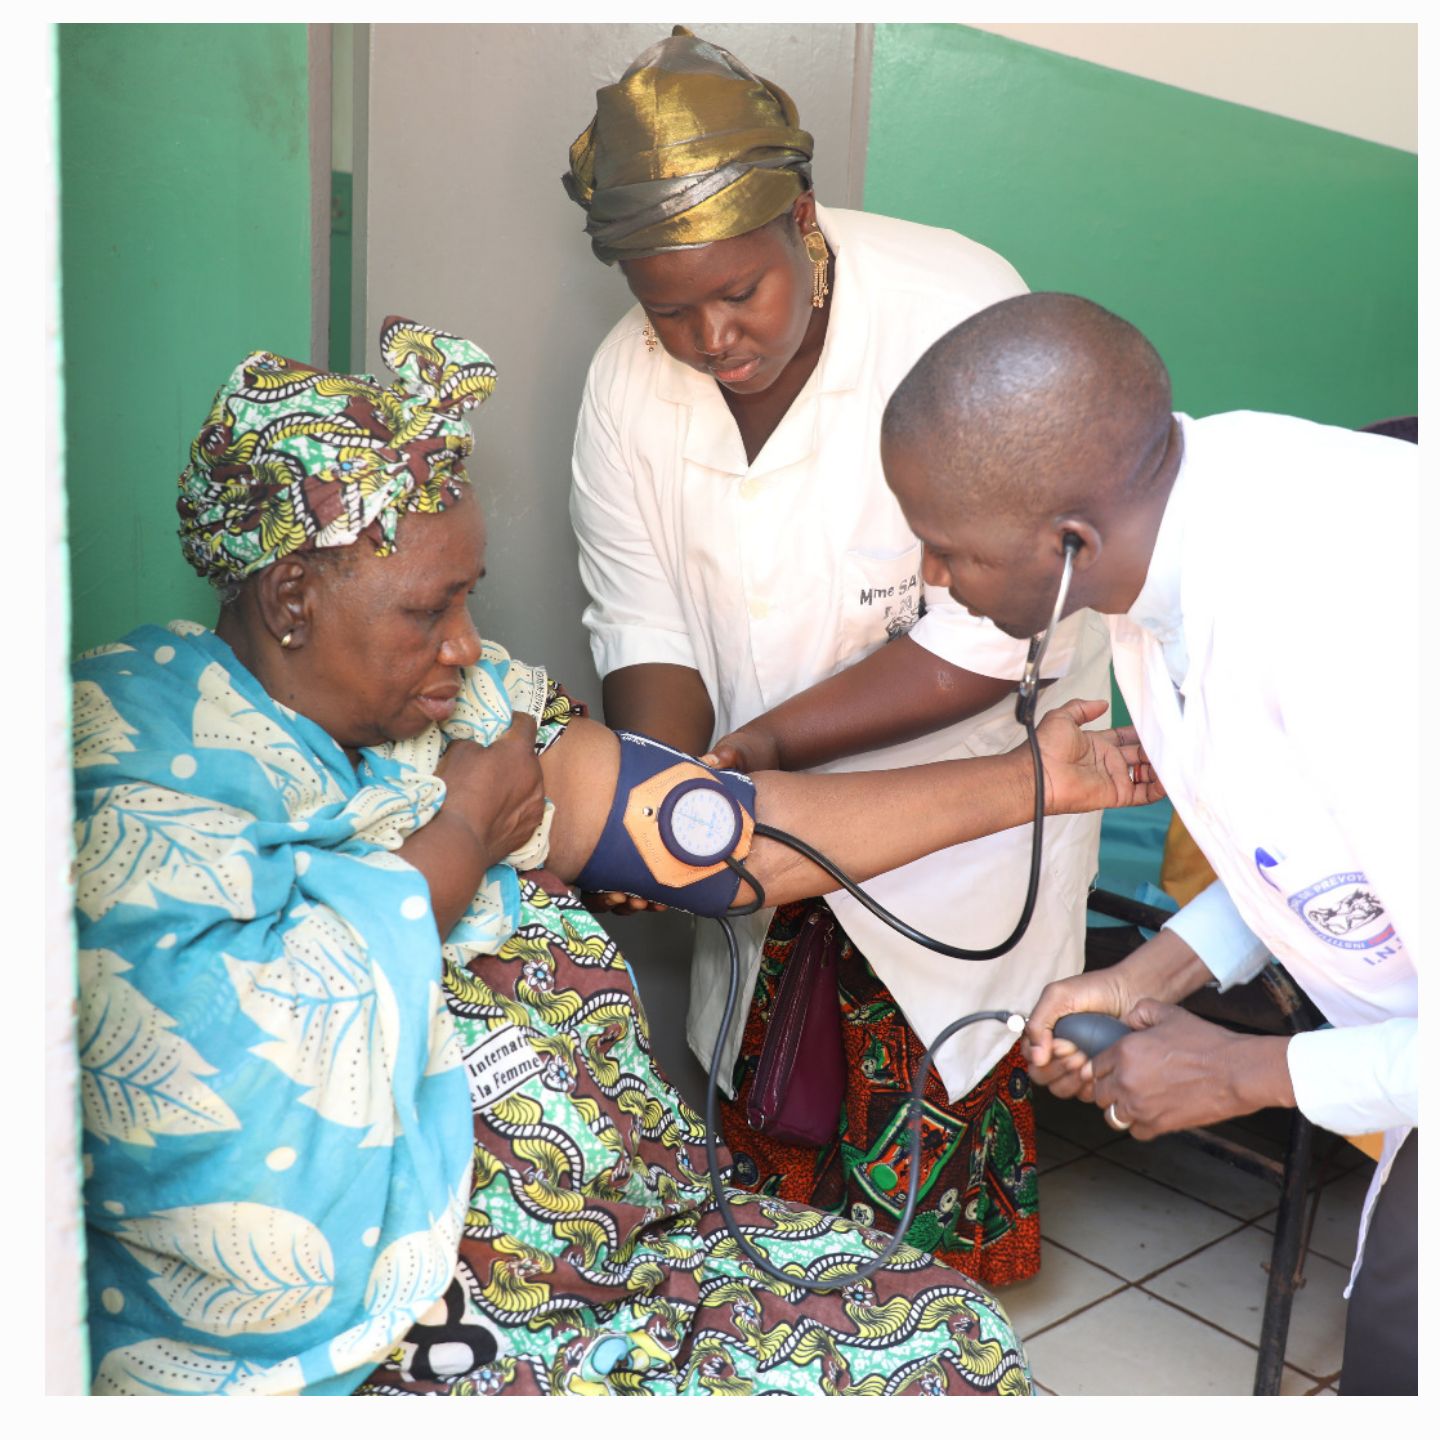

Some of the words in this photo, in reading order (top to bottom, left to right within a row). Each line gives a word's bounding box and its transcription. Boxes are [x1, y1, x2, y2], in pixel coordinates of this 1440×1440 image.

[859, 586, 895, 606] Mme
[476, 1084, 493, 1099] la
[492, 1056, 541, 1090] Femme
